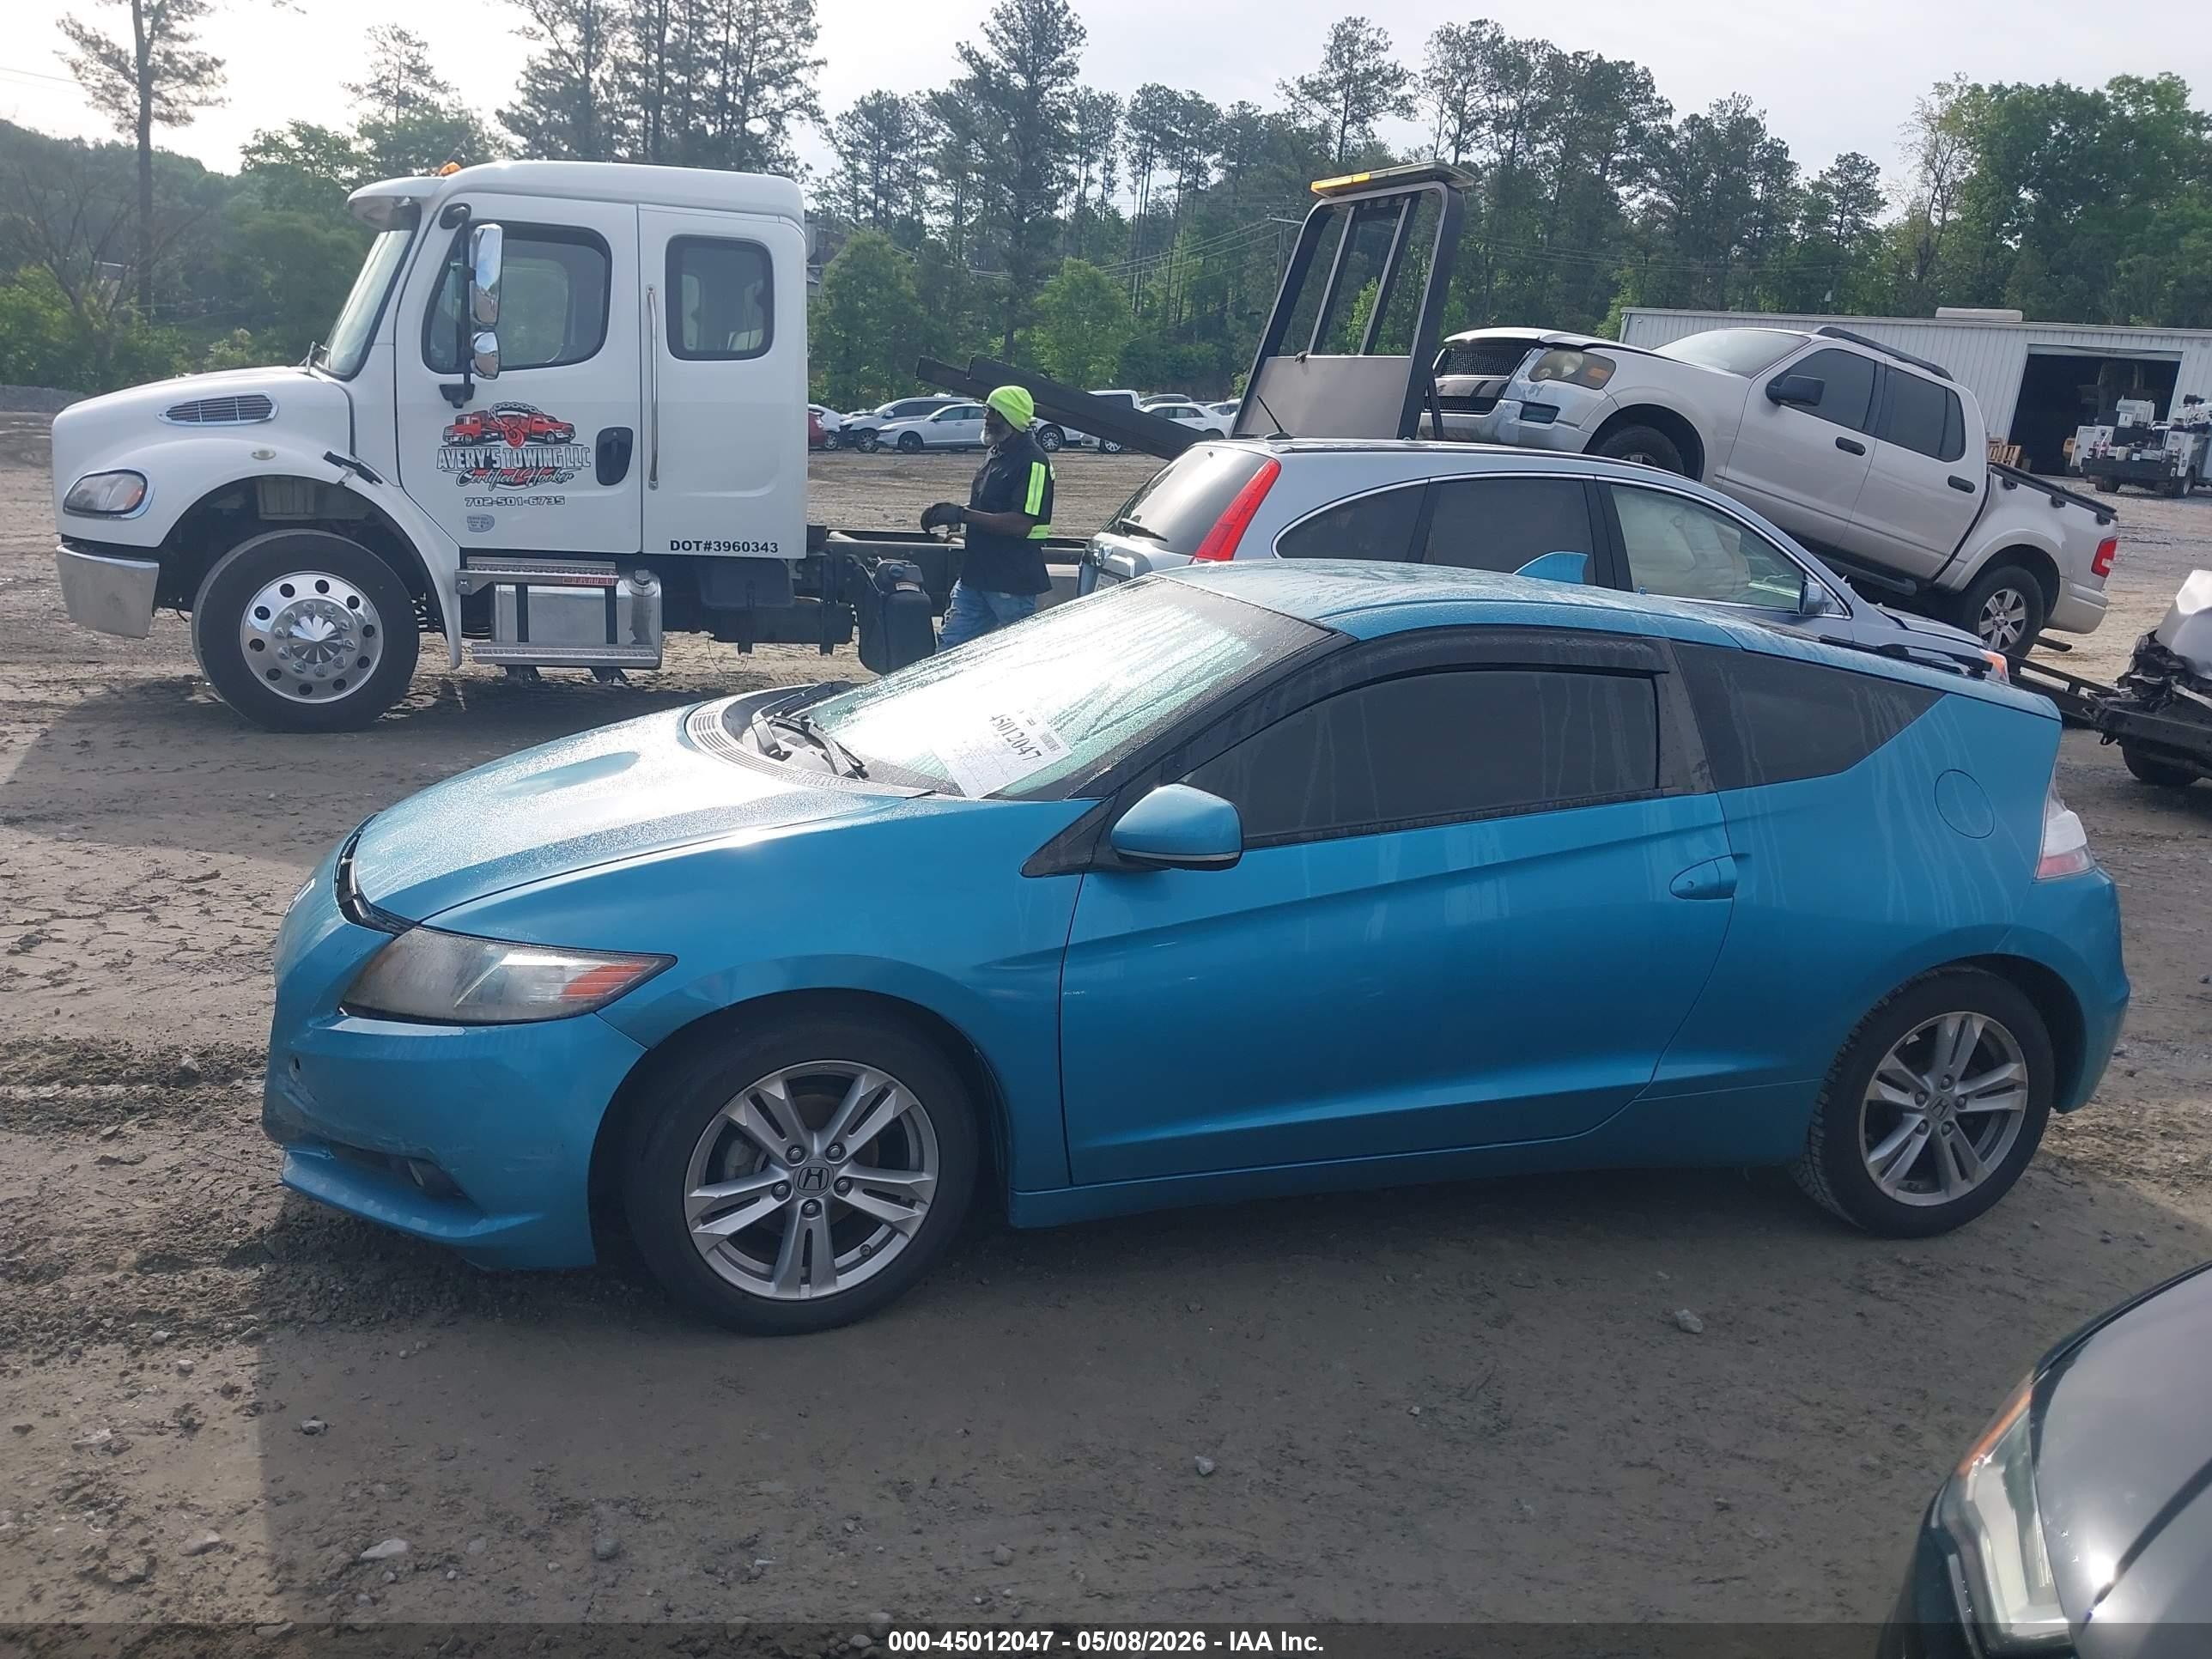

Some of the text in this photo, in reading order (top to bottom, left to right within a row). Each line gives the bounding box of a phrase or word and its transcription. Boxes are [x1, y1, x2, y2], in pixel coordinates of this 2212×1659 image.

[436, 447, 591, 469] AVERY'S TOWING LLC
[456, 467, 574, 492] Certified Hooker
[465, 495, 565, 507] 702-501-6735
[670, 540, 779, 553] DOT#3960343
